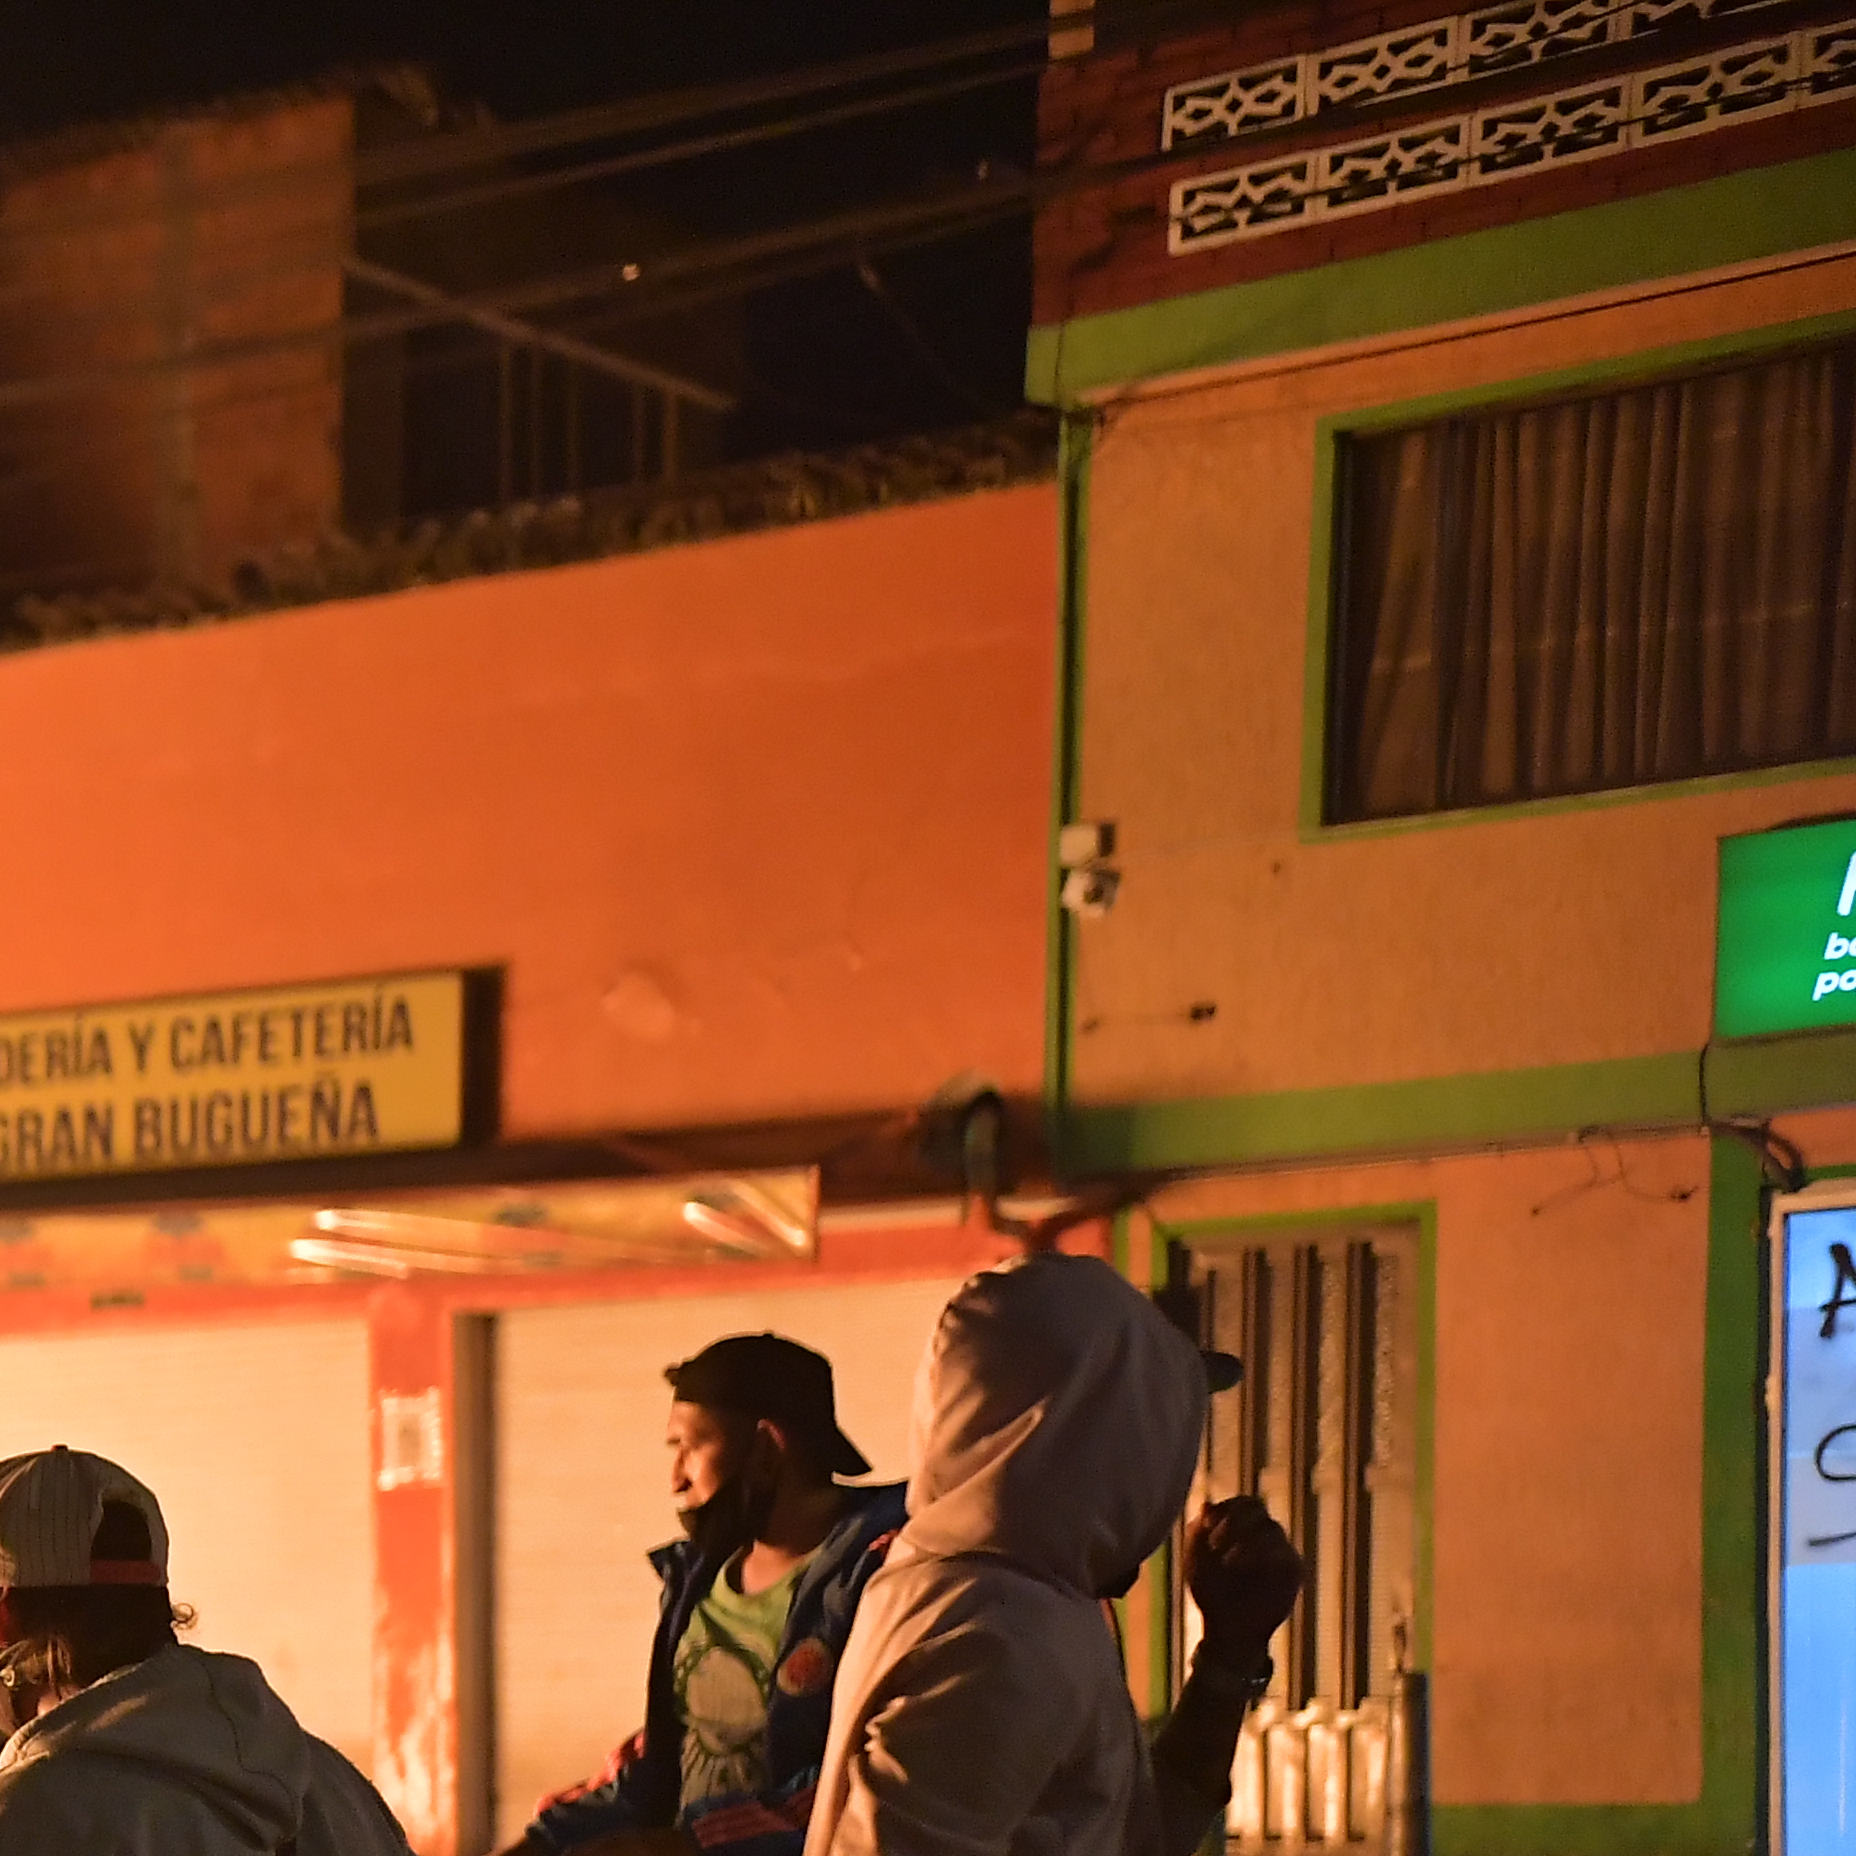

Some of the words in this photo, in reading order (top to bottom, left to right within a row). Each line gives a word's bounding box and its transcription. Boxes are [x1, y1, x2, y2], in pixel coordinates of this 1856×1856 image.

[126, 1018, 158, 1076] Y
[168, 981, 414, 1073] CAFETERÍA
[133, 1071, 381, 1160] BUGUEÑA
